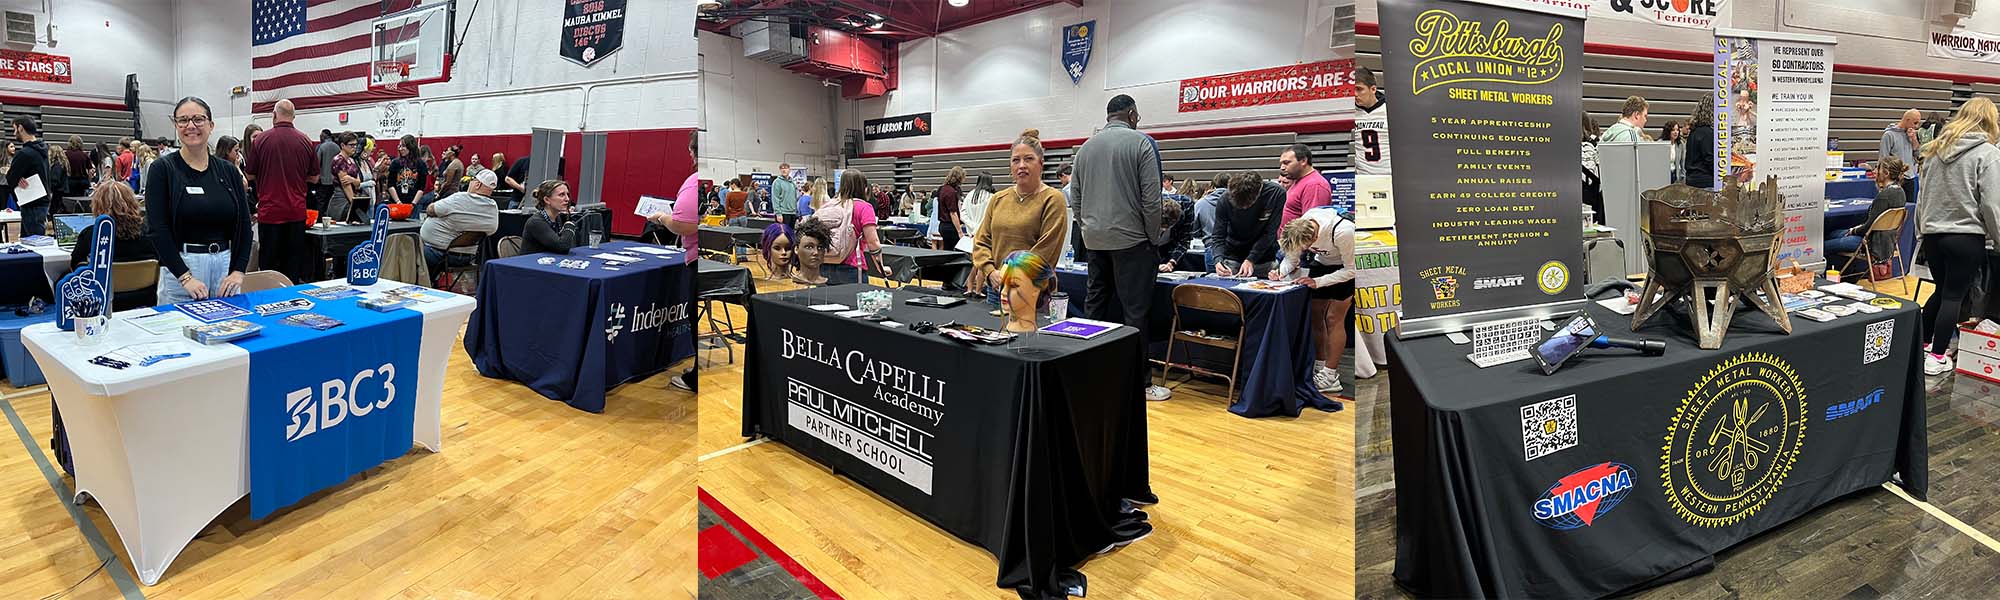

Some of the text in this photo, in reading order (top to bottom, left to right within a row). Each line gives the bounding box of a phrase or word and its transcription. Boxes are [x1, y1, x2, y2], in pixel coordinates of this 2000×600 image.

[564, 8, 622, 28] MAURA KIMMEL
[1653, 10, 1711, 28] Territory
[573, 23, 607, 38] DISCUS
[1409, 9, 1564, 66] Pittsburgh
[1717, 38, 1729, 55] 12
[1932, 31, 1975, 50] WARRIOR
[1773, 46, 1824, 57] WE REPRESENT OVER
[17, 60, 53, 74] STARS
[1428, 61, 1472, 79] LOCAL
[1476, 61, 1513, 76] UNION
[1527, 67, 1538, 79] 12
[1772, 60, 1826, 71] 60 CONTRACTORS.
[1200, 86, 1228, 100] OUR
[1231, 75, 1308, 97] WARRIORS
[1311, 71, 1345, 88] ARE
[1717, 60, 1729, 108] LOCAL
[1449, 87, 1553, 105] SHEET METAL WORKERS
[876, 121, 903, 134] WARRIOR
[904, 120, 914, 131] PIT
[1441, 117, 1467, 125] YEAR
[1470, 118, 1551, 129] APPRENTICESHIP
[1361, 129, 1382, 162] 9
[1432, 132, 1551, 143] CONTINUING EDUCATION
[1432, 220, 1481, 228] INDUSTRY
[1439, 233, 1499, 242] RETIREMENT
[1502, 231, 1541, 239] PENSION
[1478, 239, 1518, 247] ANNUITY
[1419, 265, 1467, 280] SHEET METAL
[1472, 275, 1525, 290] SMART
[1429, 299, 1461, 310] WORKERS
[781, 328, 946, 406] BELLA CAPELLI
[321, 363, 396, 430] BC3
[873, 385, 945, 426] Academy
[1682, 366, 1795, 430] SHEET METAL WORKERS
[788, 381, 933, 460] PAUL MITCHELL
[1759, 425, 1779, 438] 1880
[806, 415, 905, 475] PARTNER SCHOOL
[1680, 450, 1791, 514] WESTERN PENNSYLVANIA
[1734, 472, 1743, 484] 12
[1534, 469, 1633, 519] SMACNA
